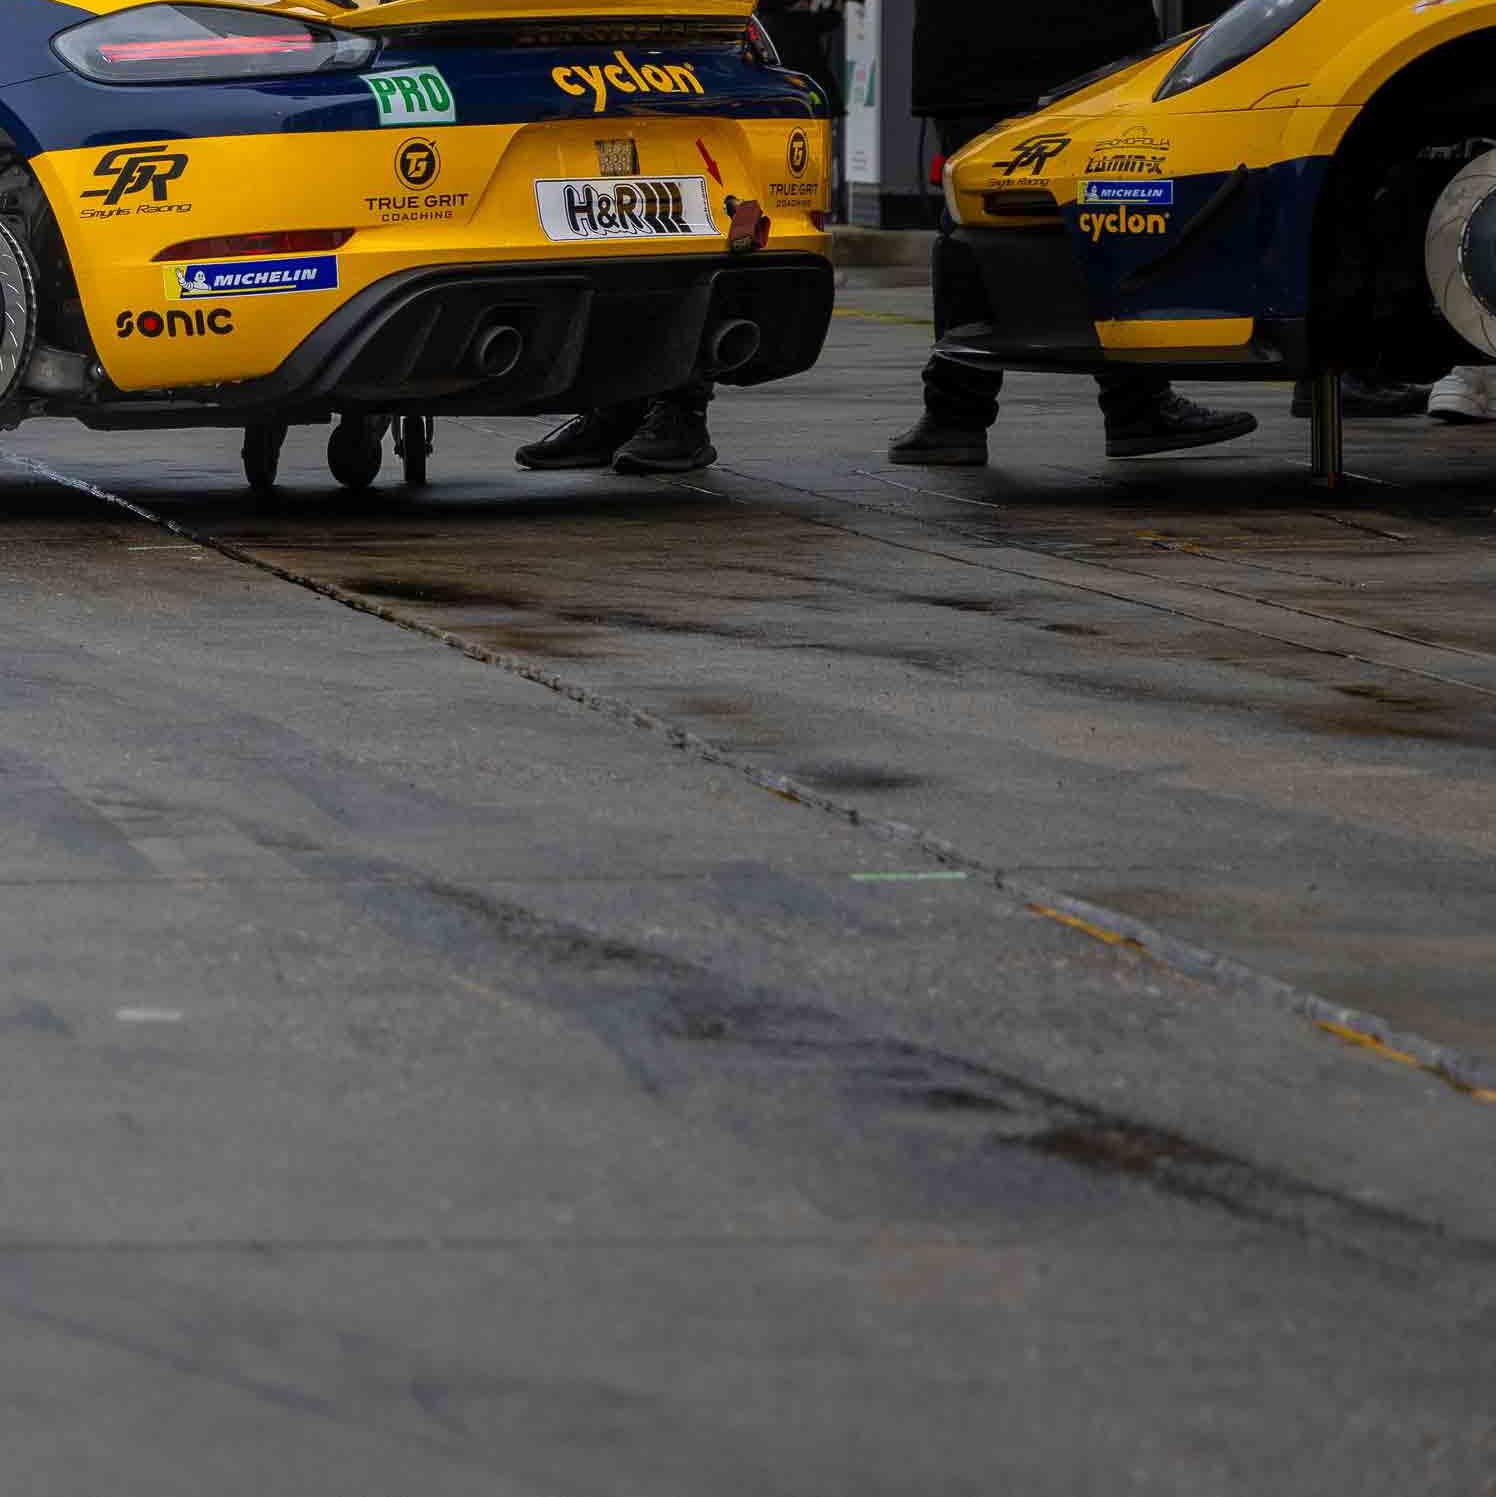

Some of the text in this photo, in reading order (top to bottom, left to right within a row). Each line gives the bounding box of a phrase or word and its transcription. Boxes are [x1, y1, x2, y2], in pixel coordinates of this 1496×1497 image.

[375, 73, 451, 116] PRO
[365, 192, 469, 211] TRUE GRIT
[1101, 188, 1163, 198] MICHELIN
[382, 209, 453, 223] COACHING
[564, 184, 648, 236] H&R
[1079, 205, 1166, 243] cyclon
[213, 267, 318, 288] MICHELIN
